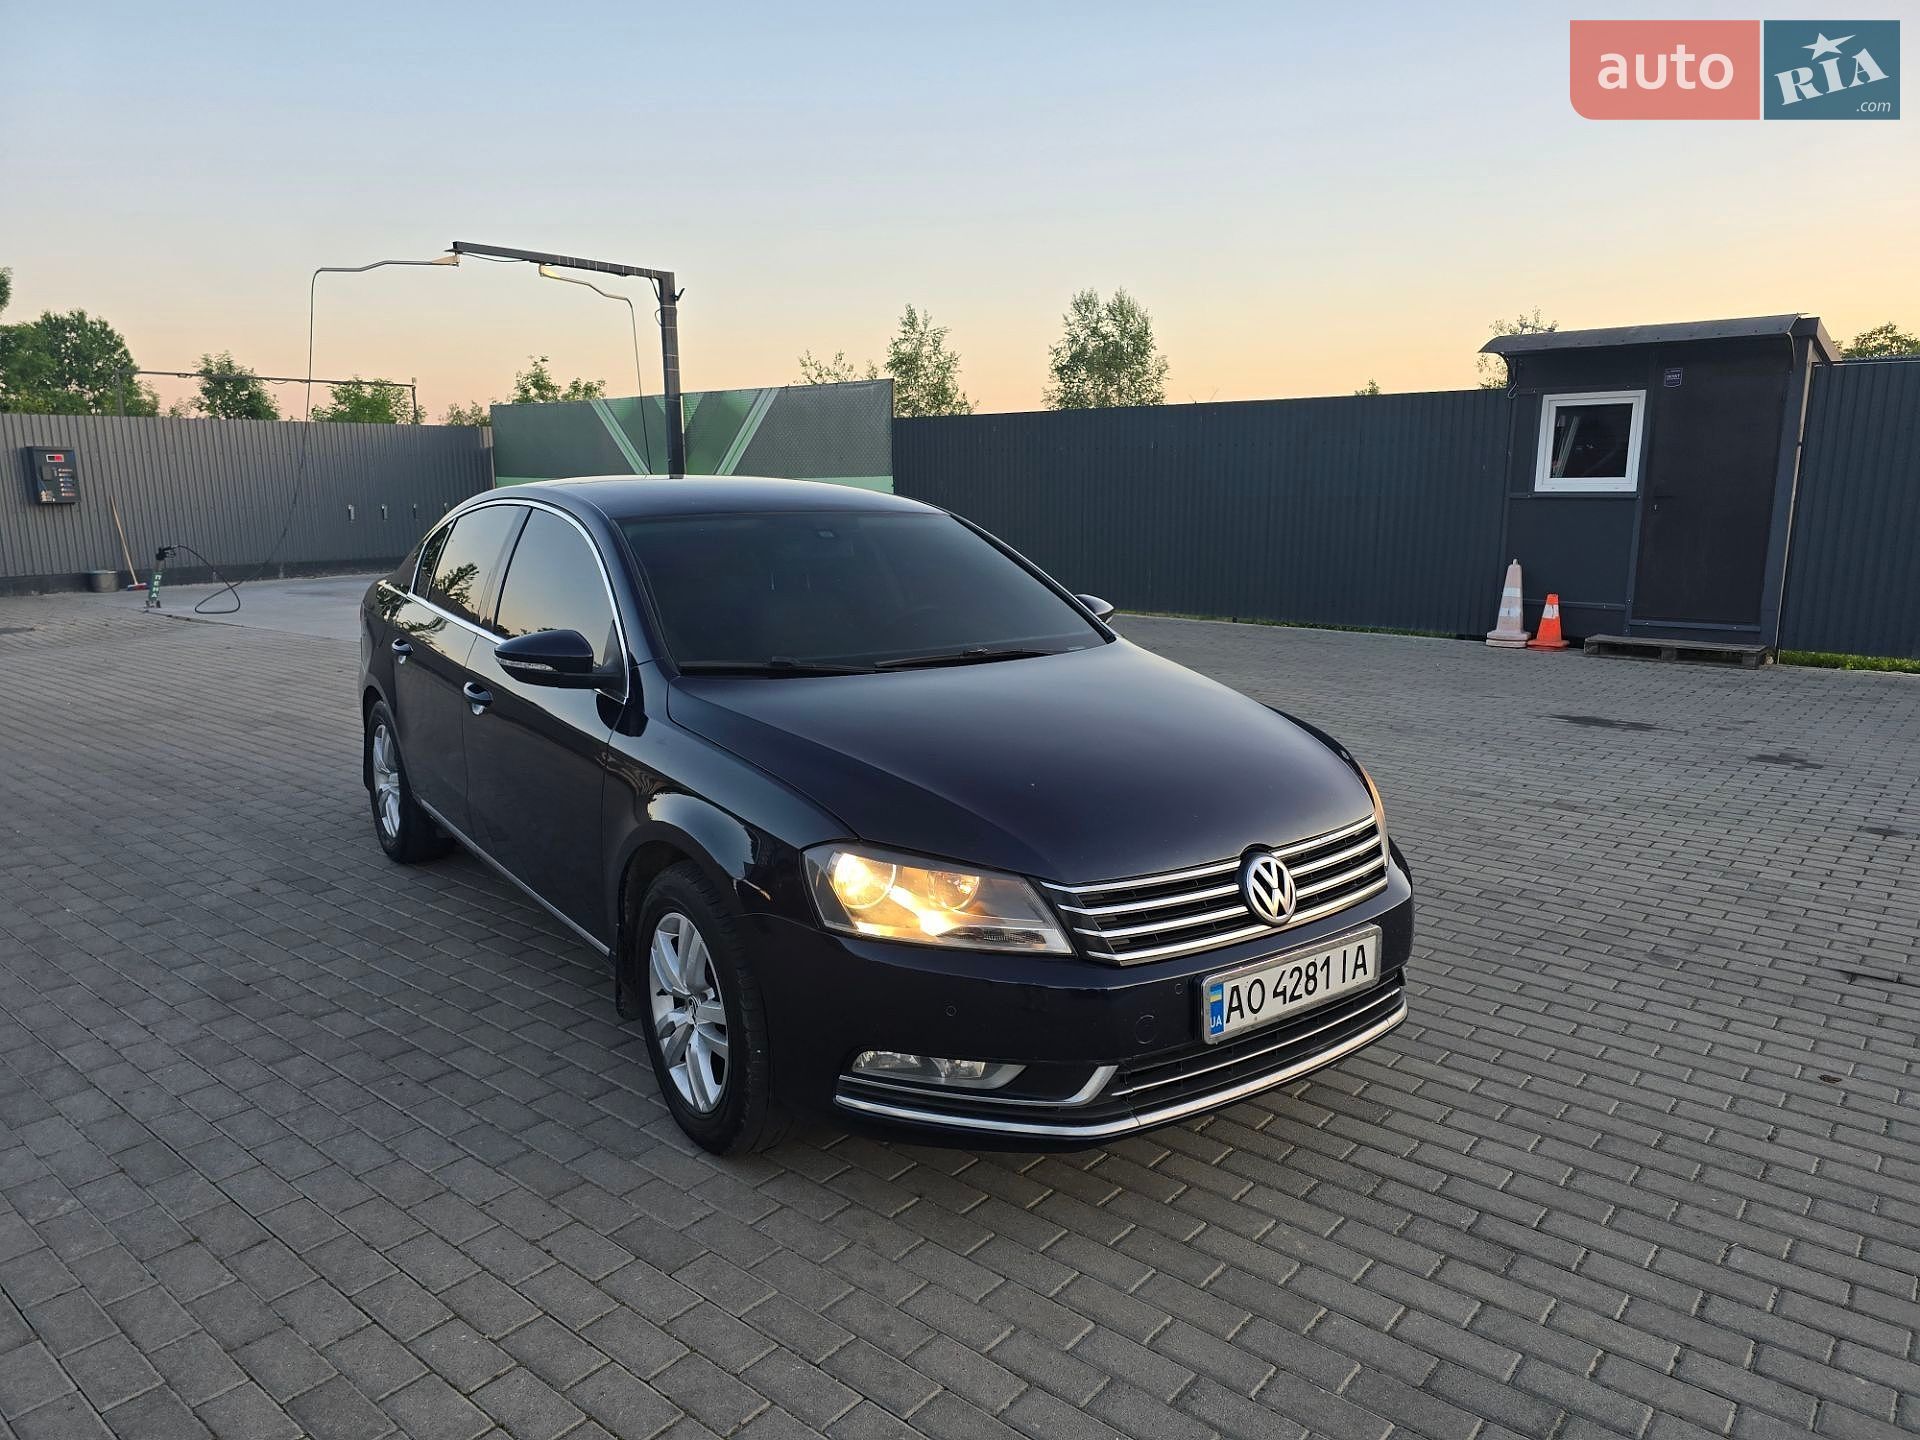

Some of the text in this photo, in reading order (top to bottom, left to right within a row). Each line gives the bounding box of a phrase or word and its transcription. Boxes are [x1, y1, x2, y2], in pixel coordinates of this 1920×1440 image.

[1226, 944, 1368, 1024] AO 4281 IA
[1210, 1015, 1222, 1028] UA
